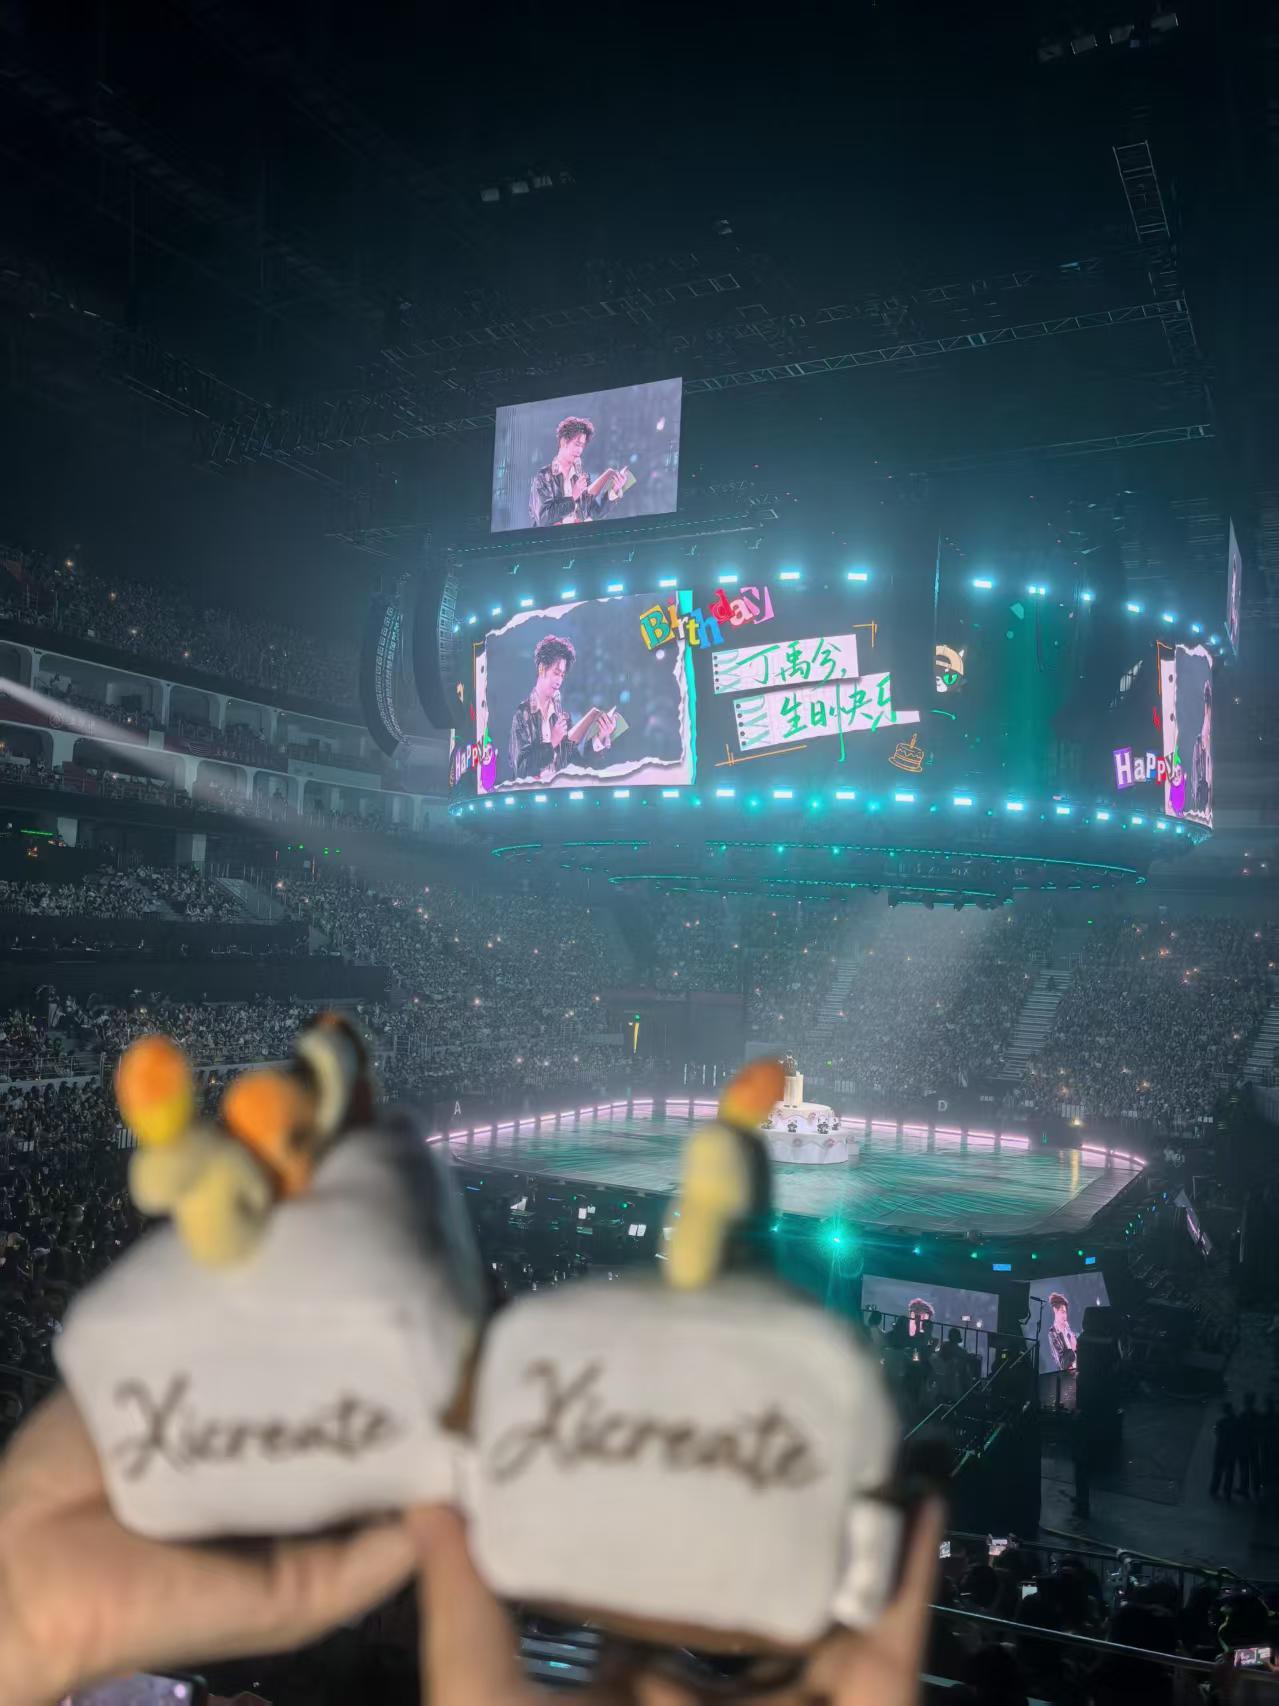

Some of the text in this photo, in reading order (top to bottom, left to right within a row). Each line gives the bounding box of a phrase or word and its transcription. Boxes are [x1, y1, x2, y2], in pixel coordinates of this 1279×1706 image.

[640, 586, 774, 650] Birthday
[453, 1101, 462, 1116] A
[937, 1099, 949, 1113] D
